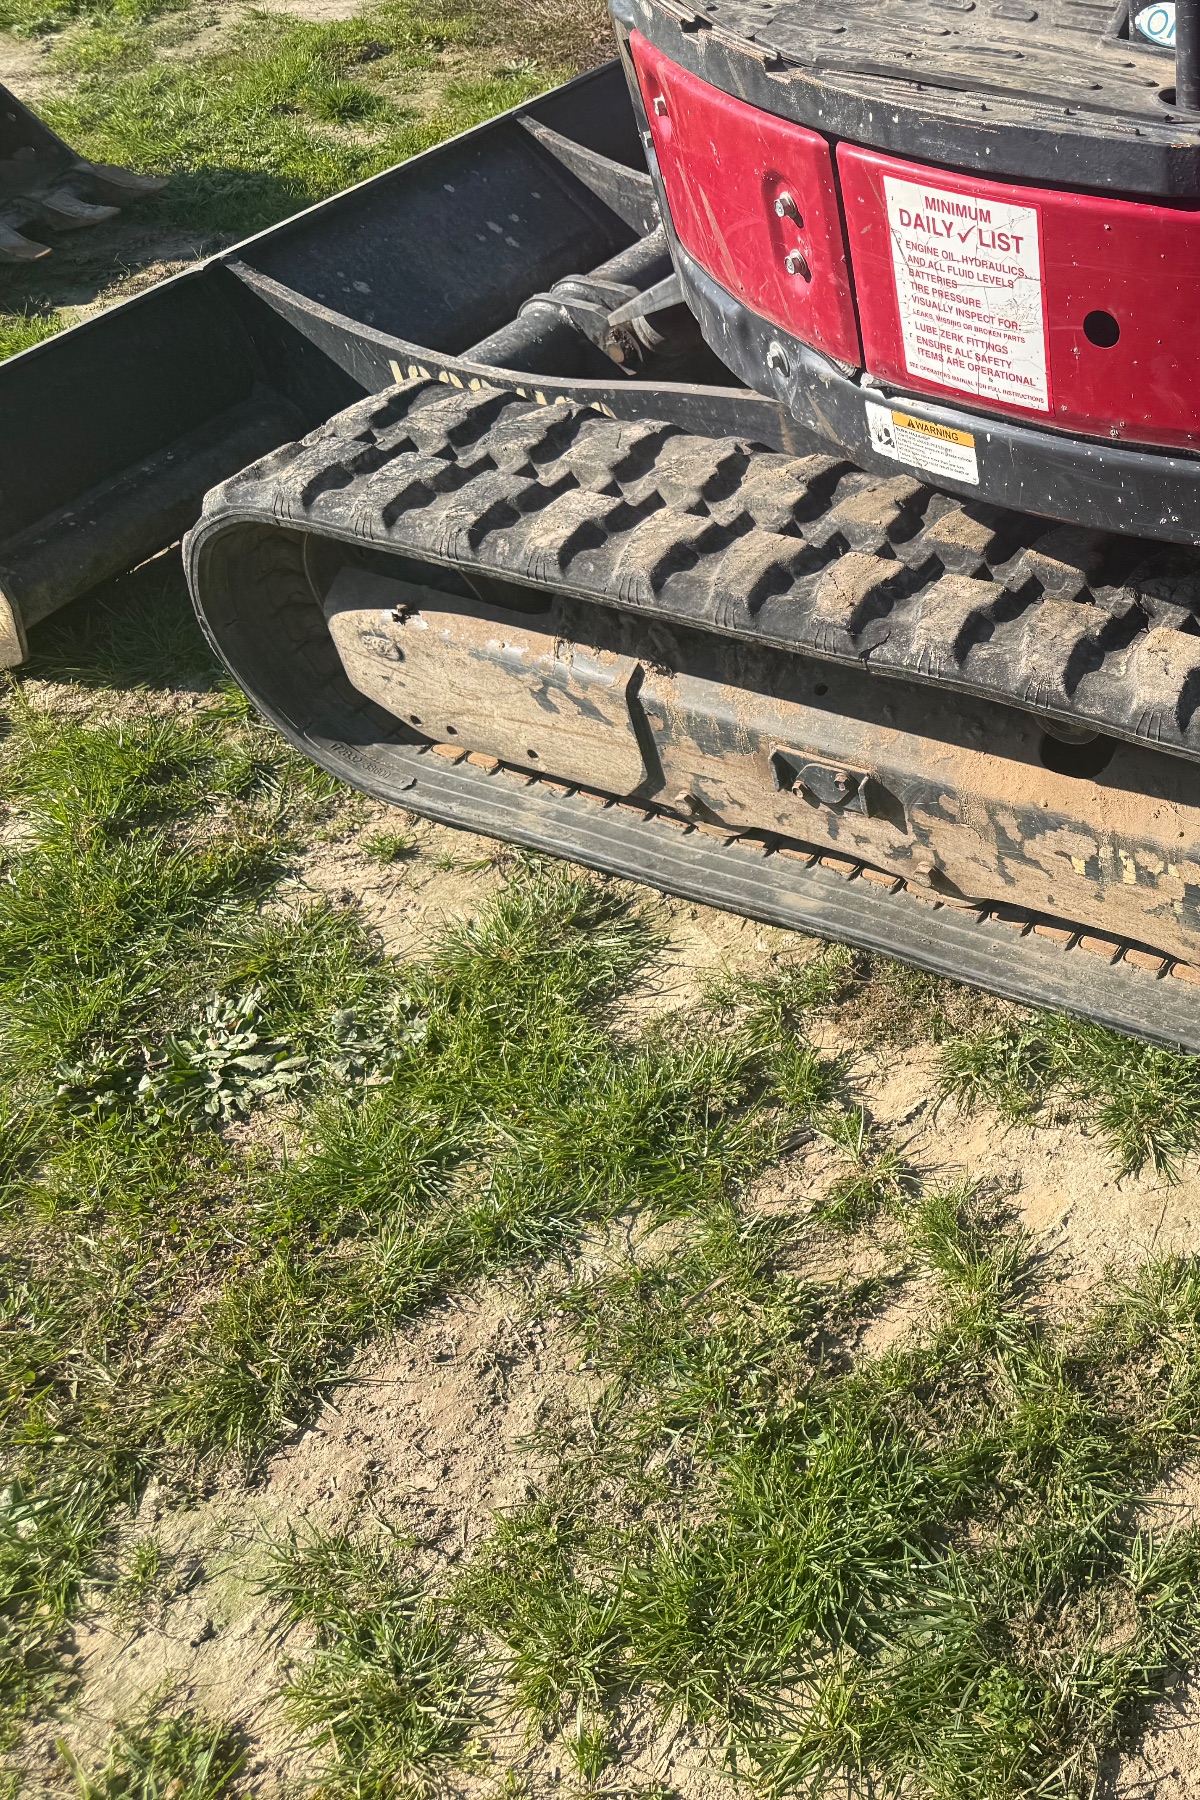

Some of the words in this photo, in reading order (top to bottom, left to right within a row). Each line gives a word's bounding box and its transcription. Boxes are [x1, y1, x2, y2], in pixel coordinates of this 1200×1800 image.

[924, 195, 992, 224] MINIMUM
[898, 207, 954, 239] DAILY
[978, 227, 1025, 254] LIST
[905, 240, 940, 257] ENGINE
[907, 254, 926, 267] AND
[928, 261, 946, 273] ALL
[947, 265, 975, 280] FLUID
[976, 272, 1014, 289] LEVELS
[908, 267, 958, 289] BATTERIES
[910, 281, 930, 295] TIRE
[931, 288, 982, 308] PRESSURE
[911, 294, 953, 315] VISUALLY
[955, 307, 995, 325] INSPECT
[914, 321, 939, 336] LUBE
[940, 329, 965, 344] ZERK
[966, 336, 1009, 355] FITTINGS
[935, 314, 962, 328] MISSING
[962, 323, 973, 331] OR
[973, 325, 1002, 338] BROKEN
[1003, 333, 1026, 344] PARTS
[916, 335, 953, 354] ENSURE
[954, 347, 973, 360] ALL
[974, 352, 1012, 369] SAFETY
[917, 347, 945, 363] ITEMS
[946, 356, 966, 369] ARE
[967, 362, 1037, 387] OPERATIONAL
[909, 361, 919, 369] SEE
[951, 375, 975, 387] MANUAL
[975, 381, 987, 390] FOR
[987, 385, 1002, 394] FULL
[1002, 389, 1045, 404] INSTRUCTIONS
[914, 420, 959, 442] WARNING
